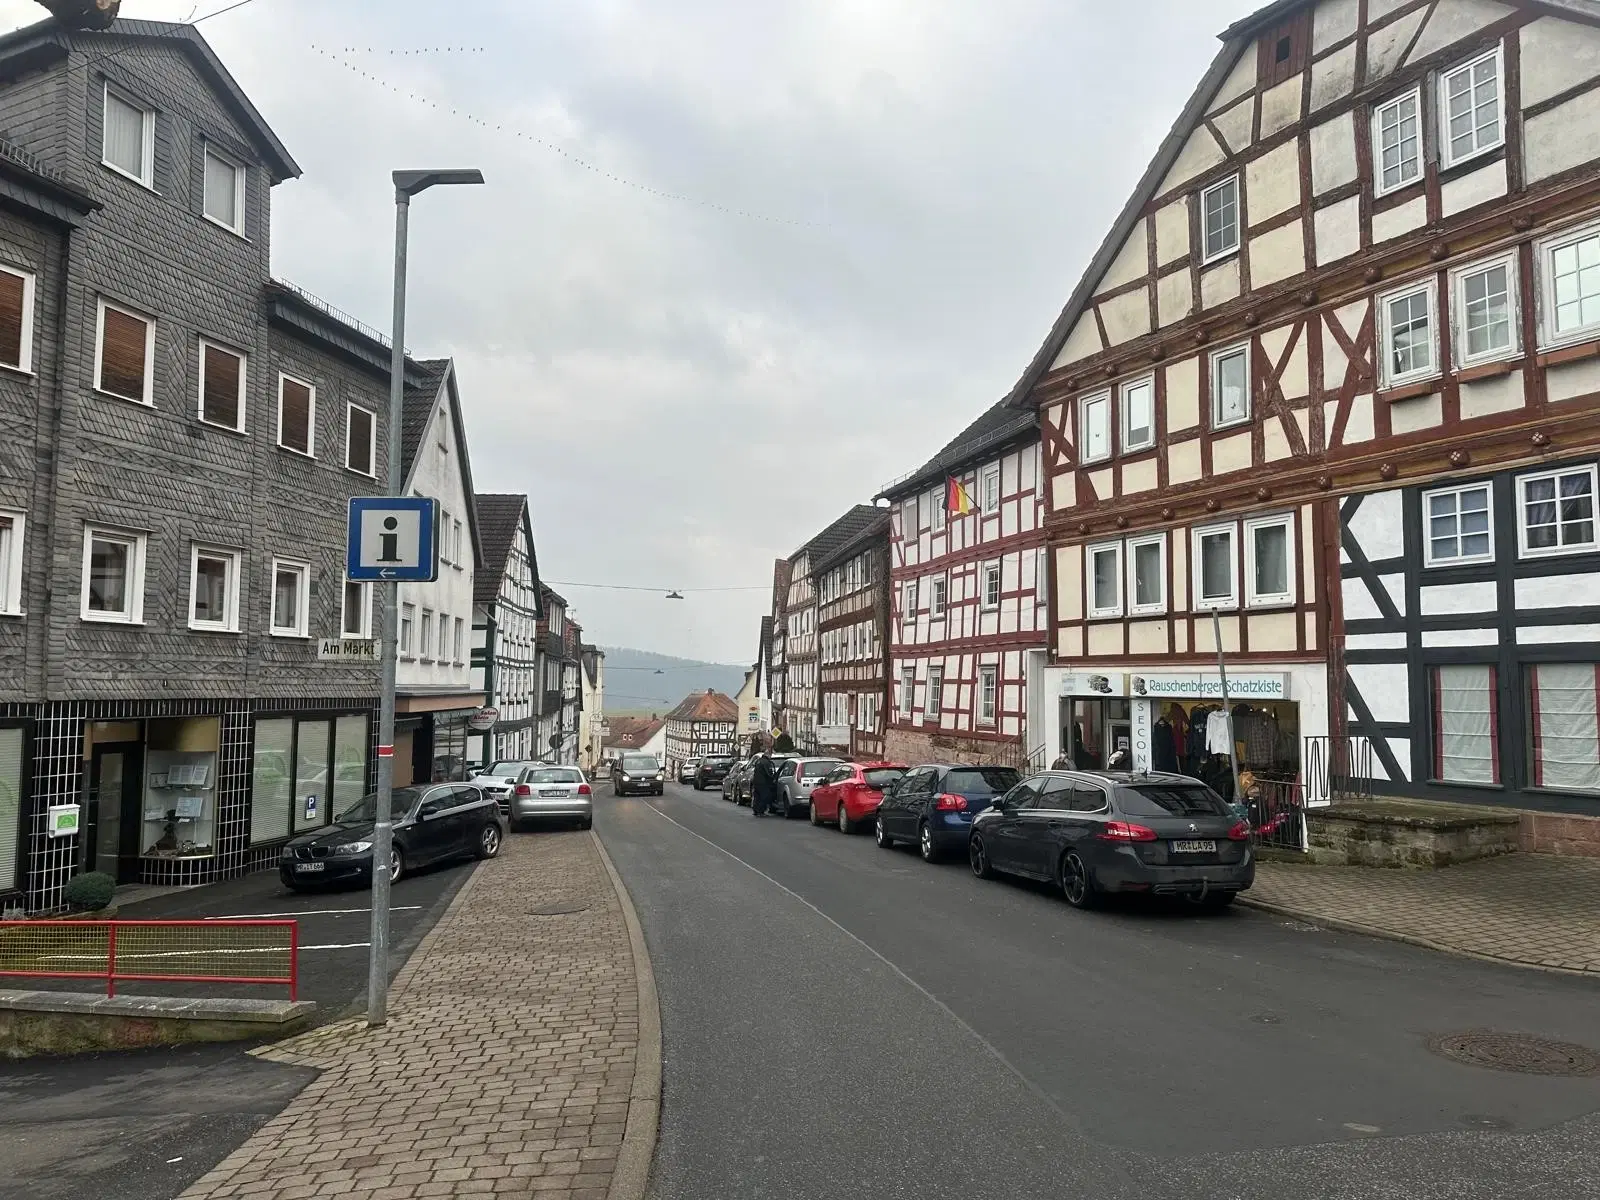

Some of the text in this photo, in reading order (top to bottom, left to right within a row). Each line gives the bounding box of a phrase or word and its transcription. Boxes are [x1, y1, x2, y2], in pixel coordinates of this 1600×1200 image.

[322, 641, 375, 655] Am Markt
[1149, 679, 1282, 693] Rauschenberger Schatzkiste
[308, 797, 314, 808] P
